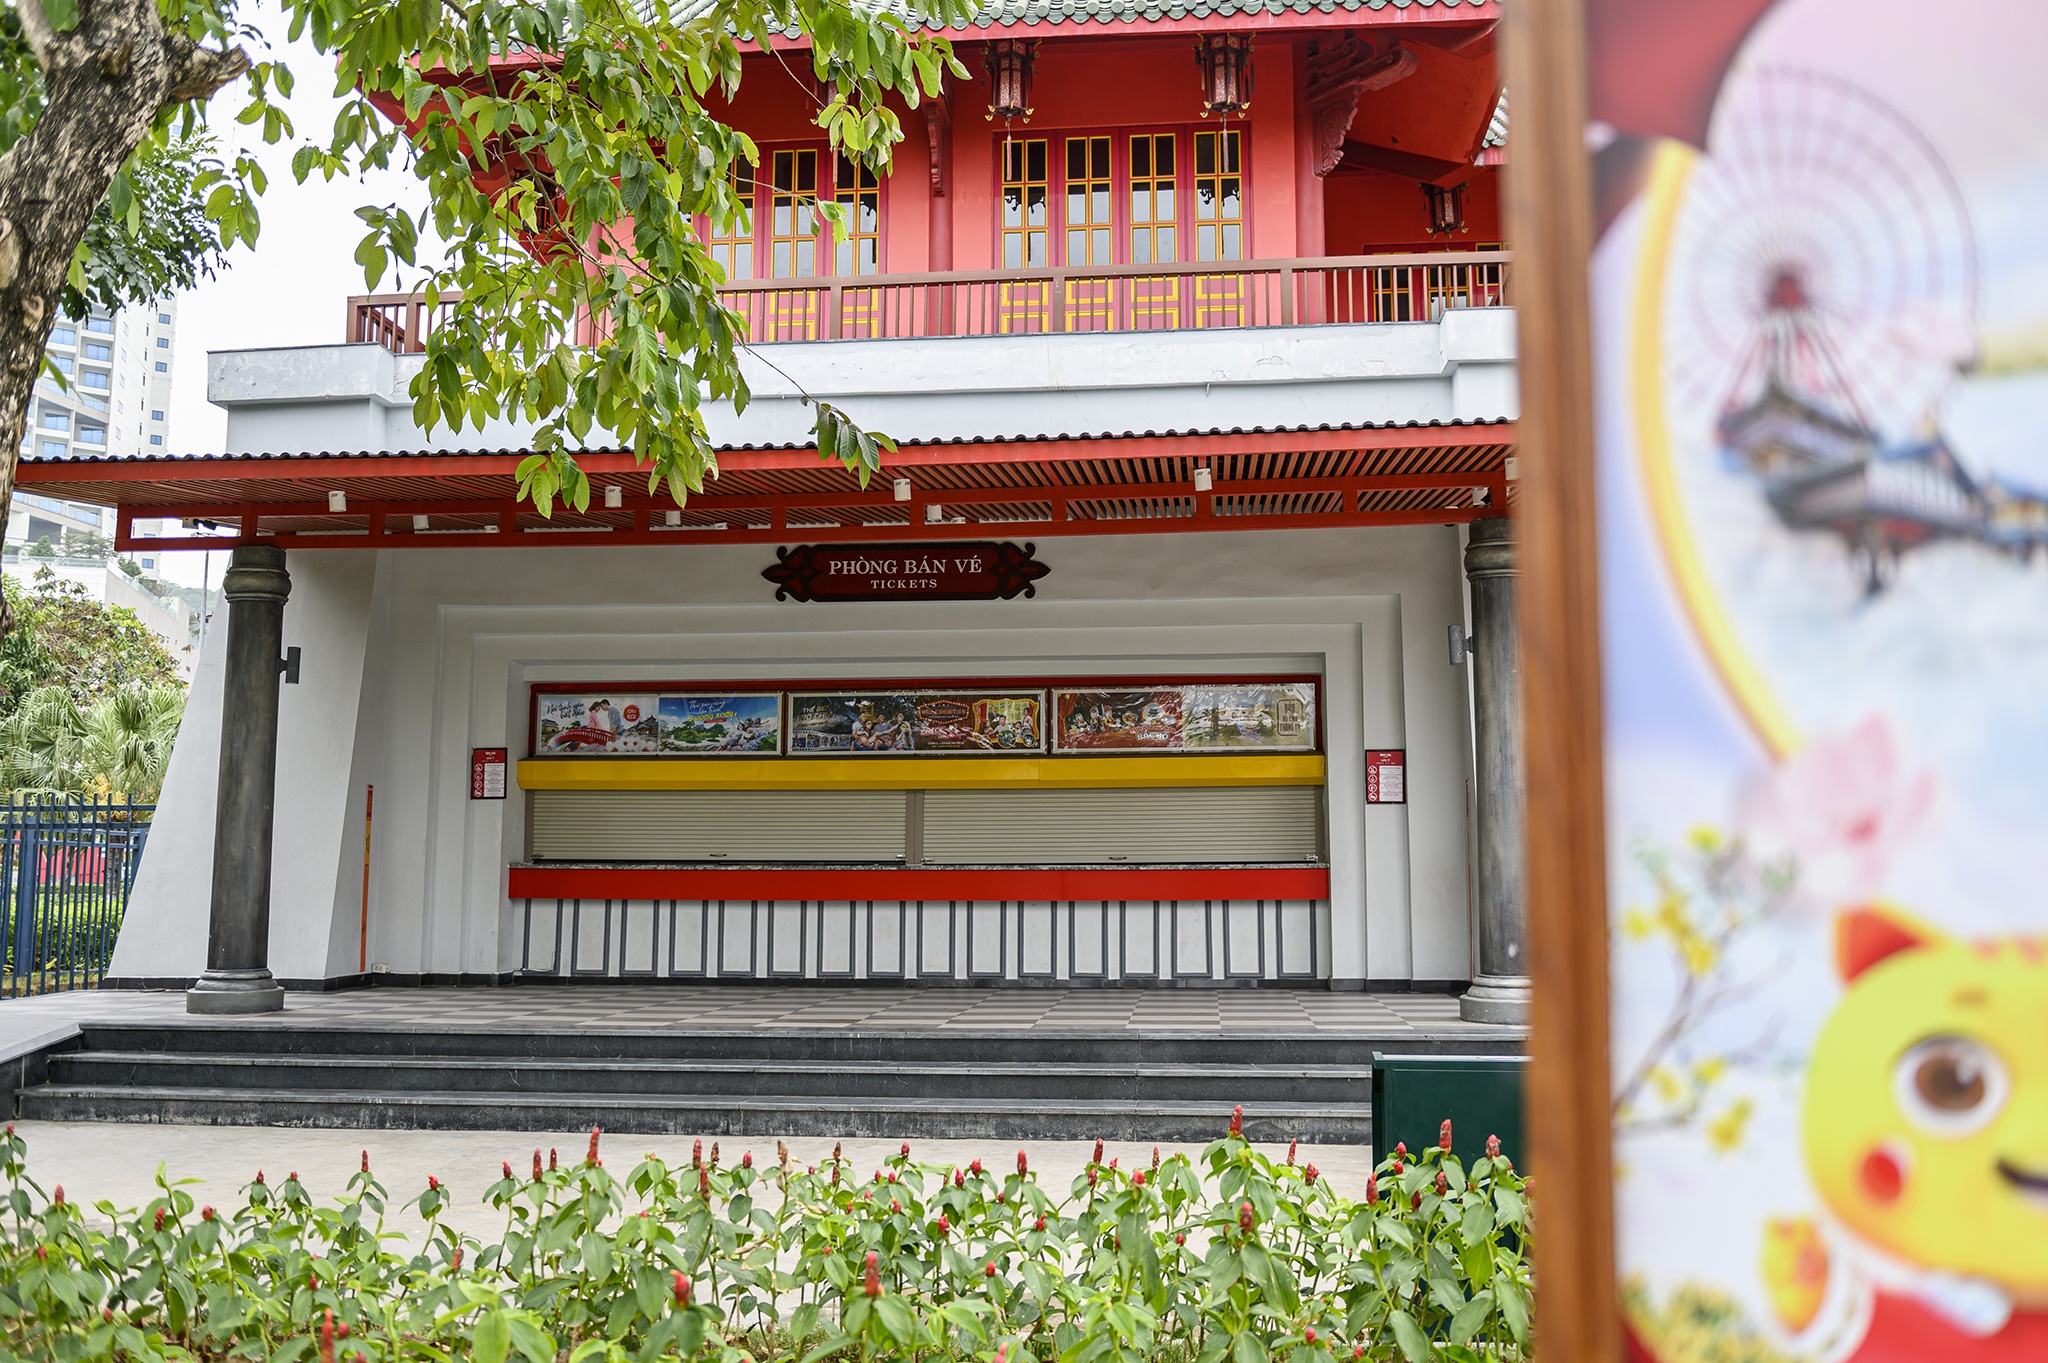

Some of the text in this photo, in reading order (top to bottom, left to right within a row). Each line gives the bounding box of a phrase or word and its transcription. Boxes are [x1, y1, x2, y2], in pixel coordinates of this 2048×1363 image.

[829, 554, 983, 575] PHÒNG BÁN VÉ
[870, 579, 938, 589] TICKETS
